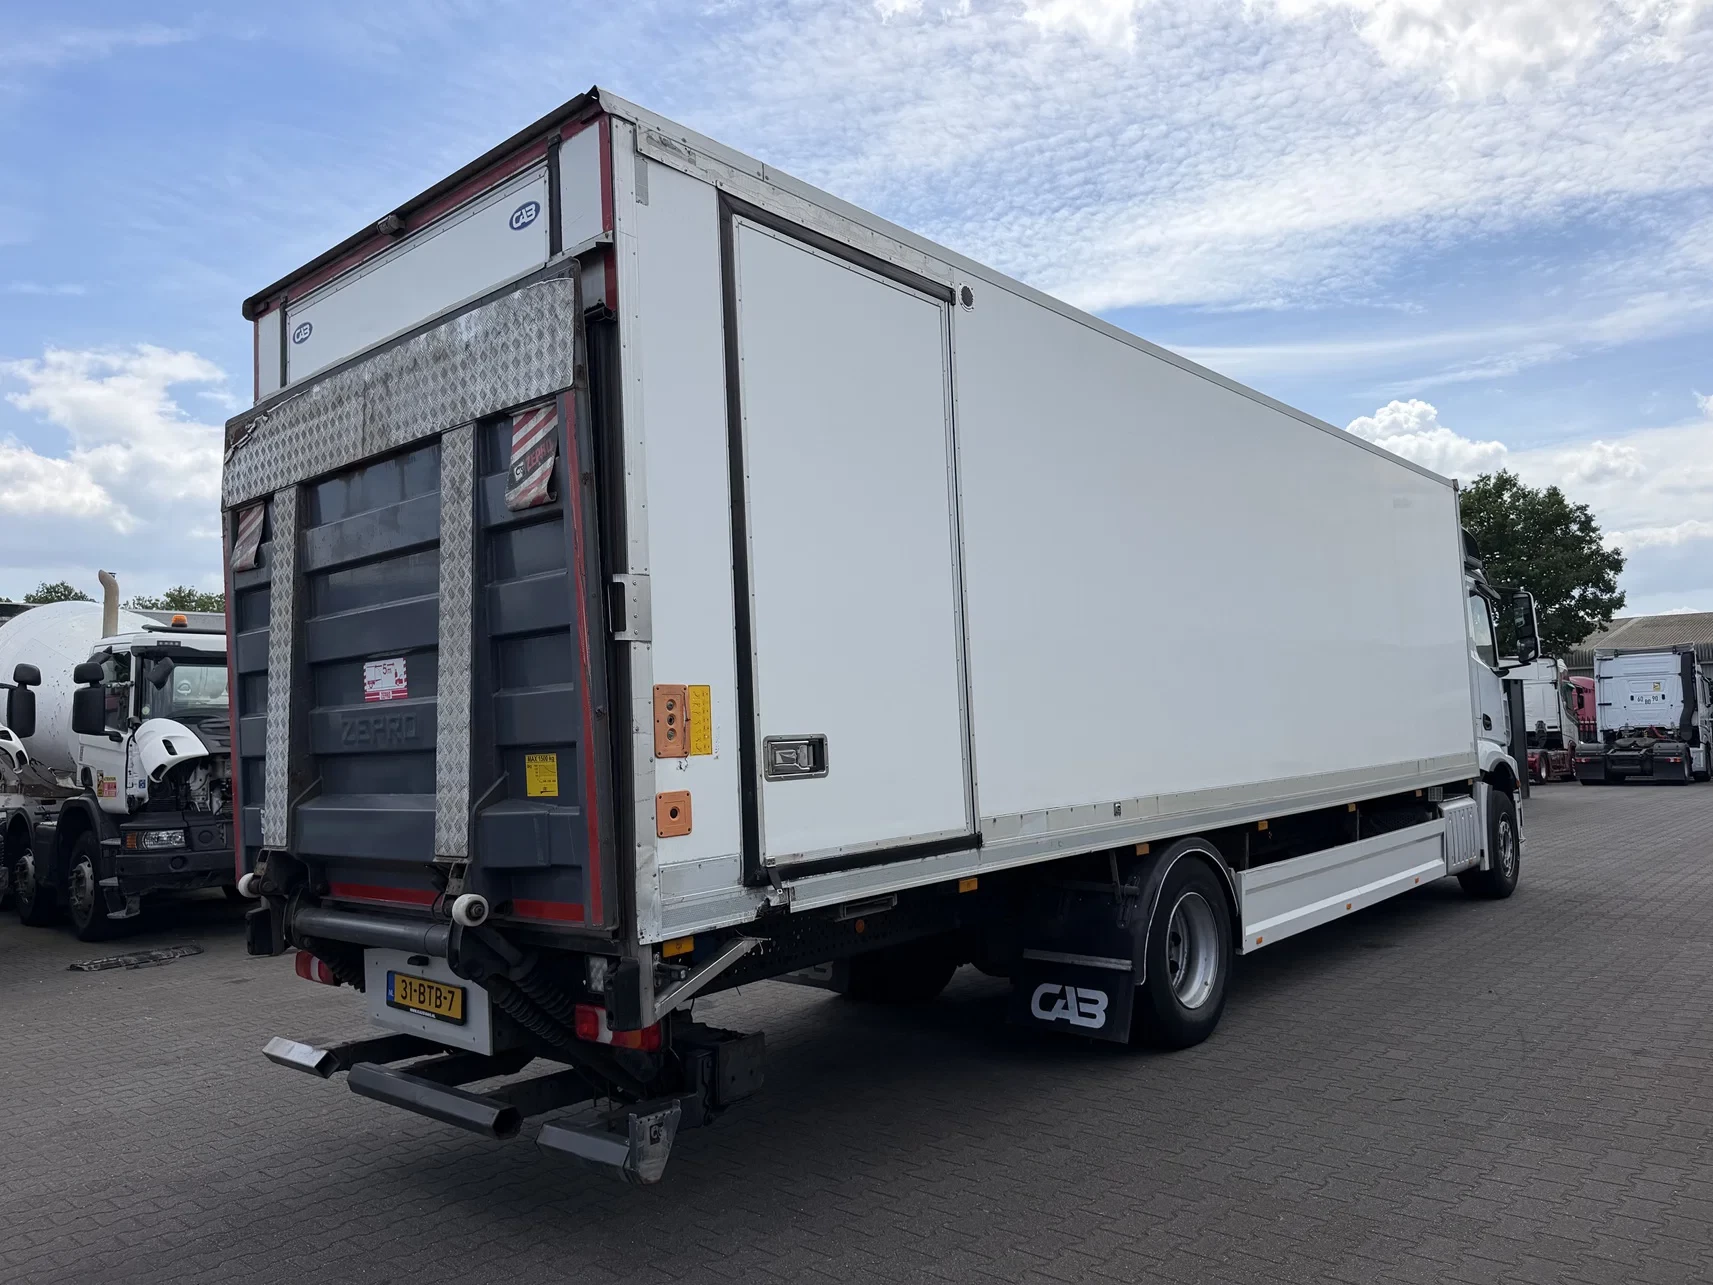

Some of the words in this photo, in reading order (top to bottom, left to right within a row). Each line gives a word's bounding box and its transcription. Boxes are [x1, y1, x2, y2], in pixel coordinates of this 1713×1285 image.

[513, 203, 536, 228] CAB
[295, 324, 310, 342] CAB
[341, 712, 418, 746] ZEPRO
[401, 980, 455, 1012] 31-BTB-7
[1031, 982, 1109, 1029] CAB
